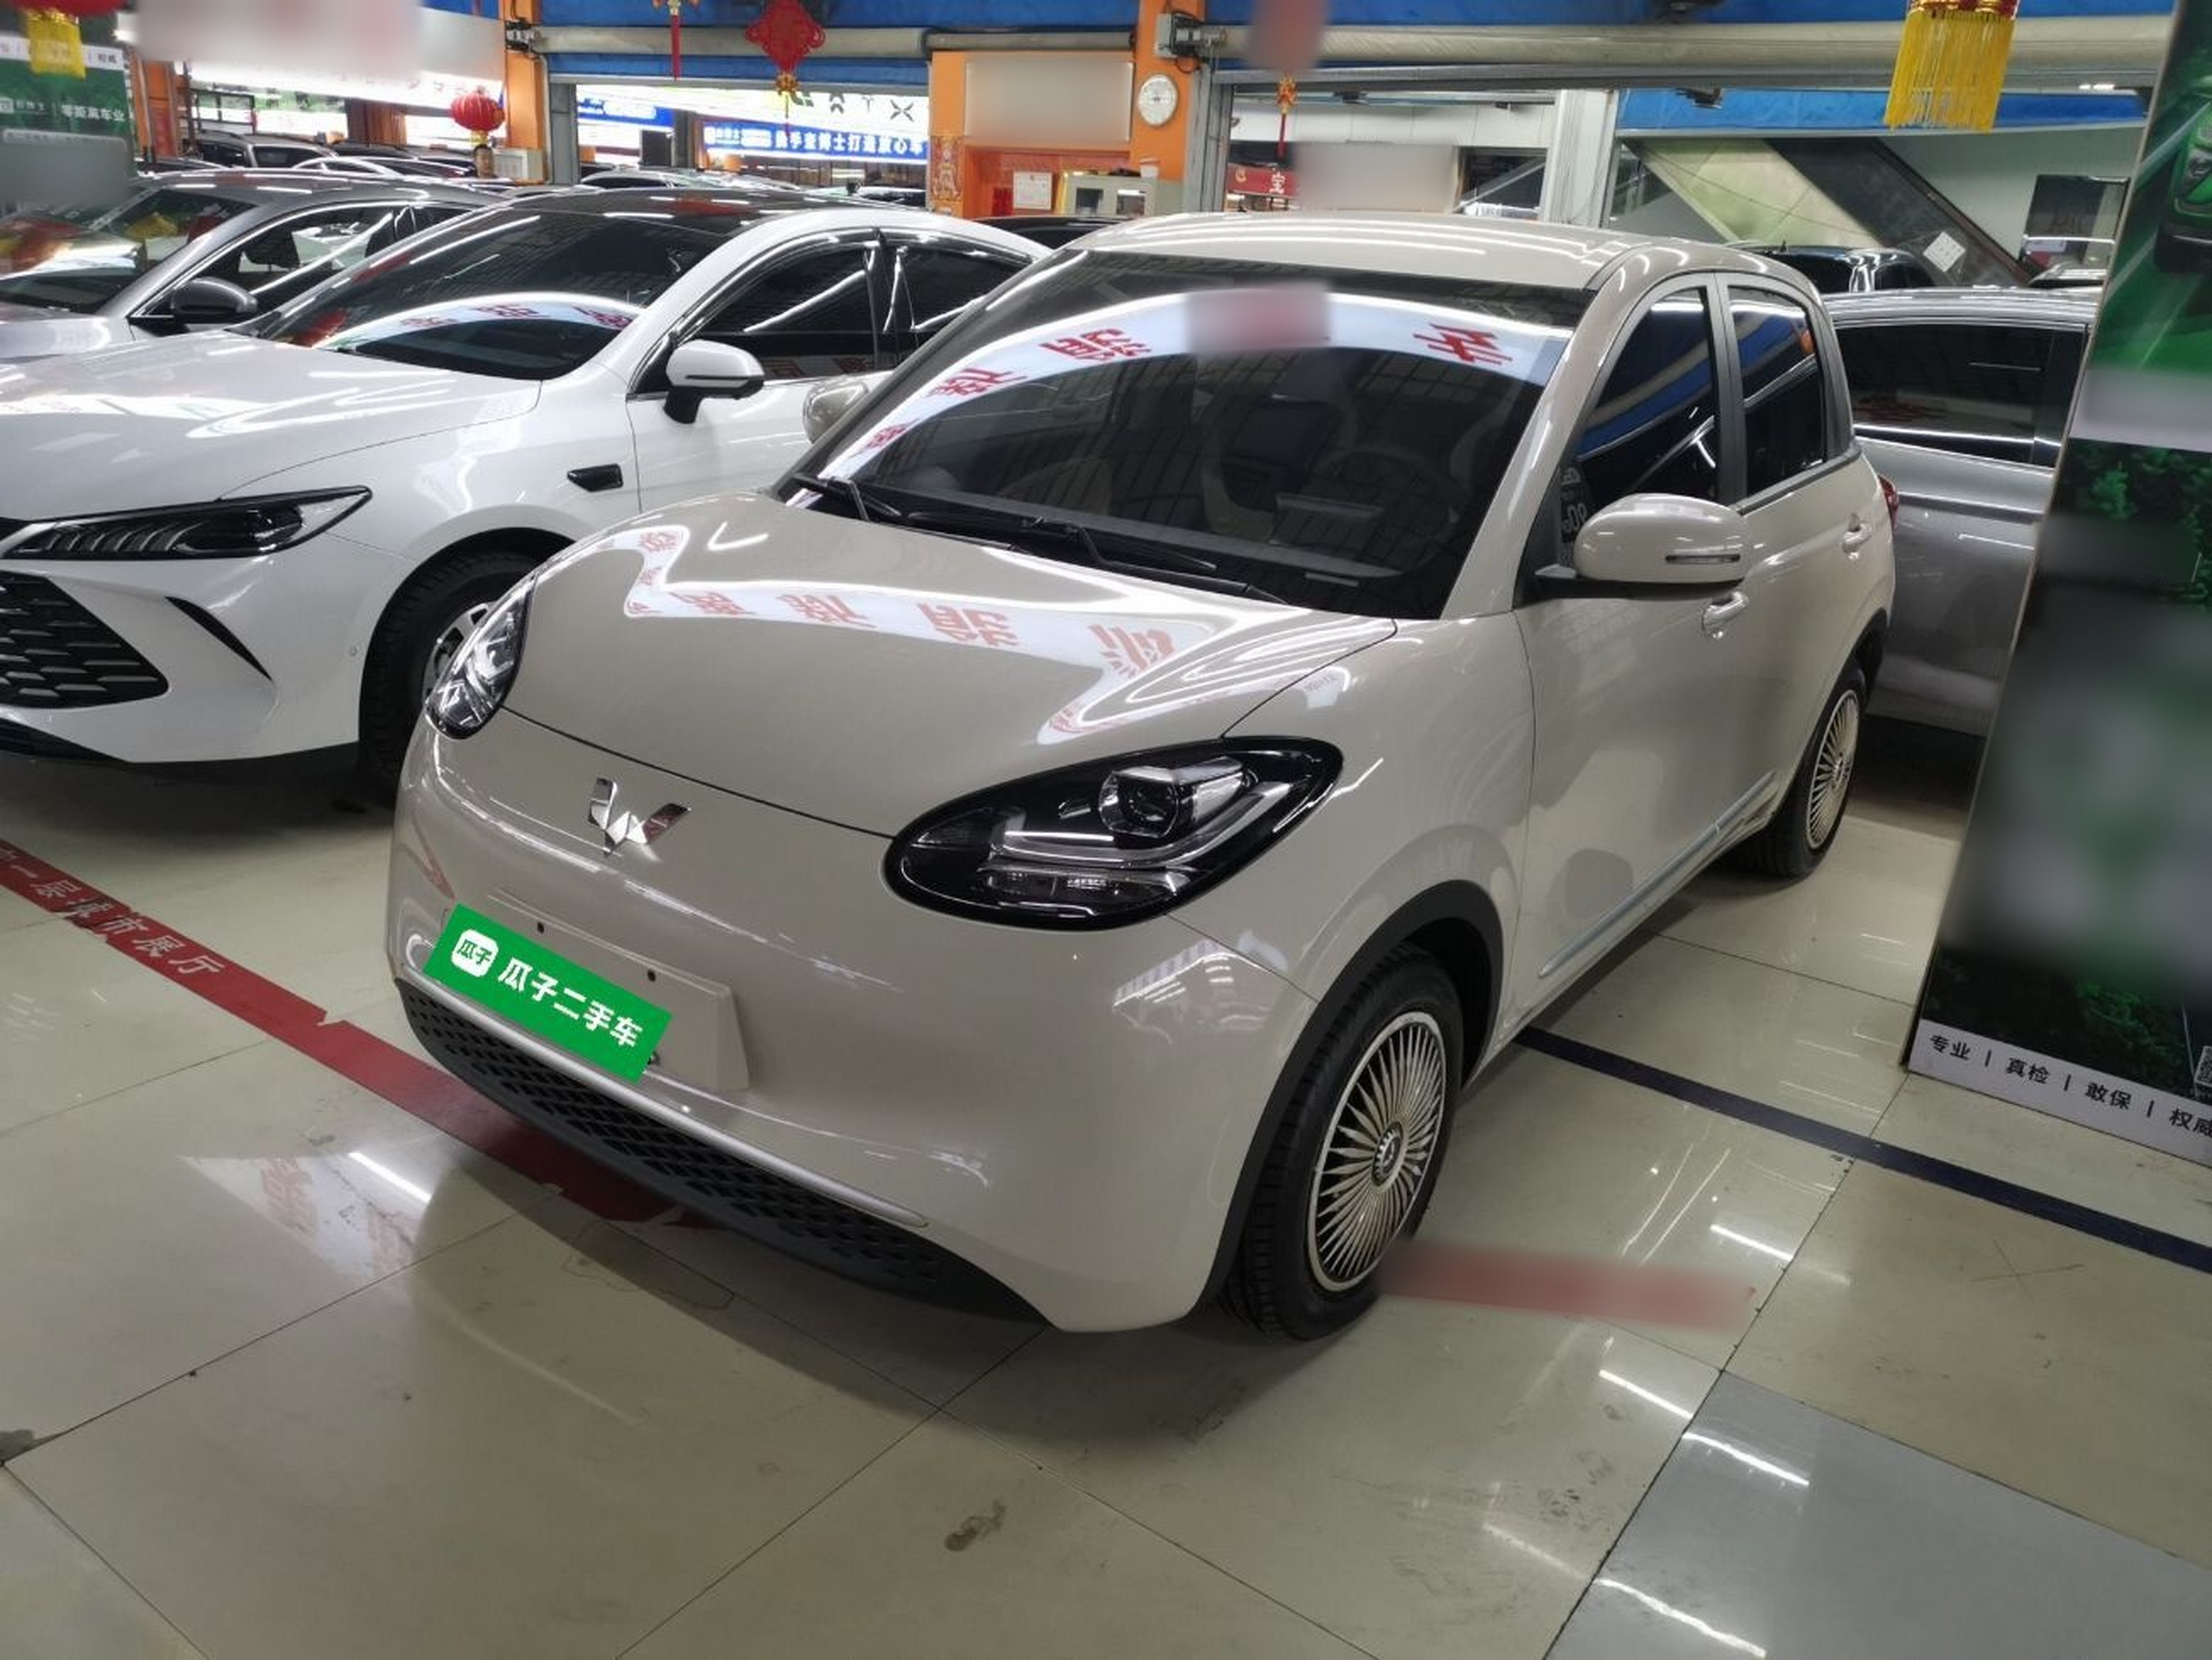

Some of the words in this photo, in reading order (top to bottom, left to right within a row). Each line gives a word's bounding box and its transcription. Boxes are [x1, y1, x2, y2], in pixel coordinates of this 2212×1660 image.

[1929, 1035, 1971, 1061] 专业
[2005, 1057, 2050, 1084] 真检
[2085, 1082, 2133, 1110] 敢保
[2169, 1108, 2212, 1139] 权威
